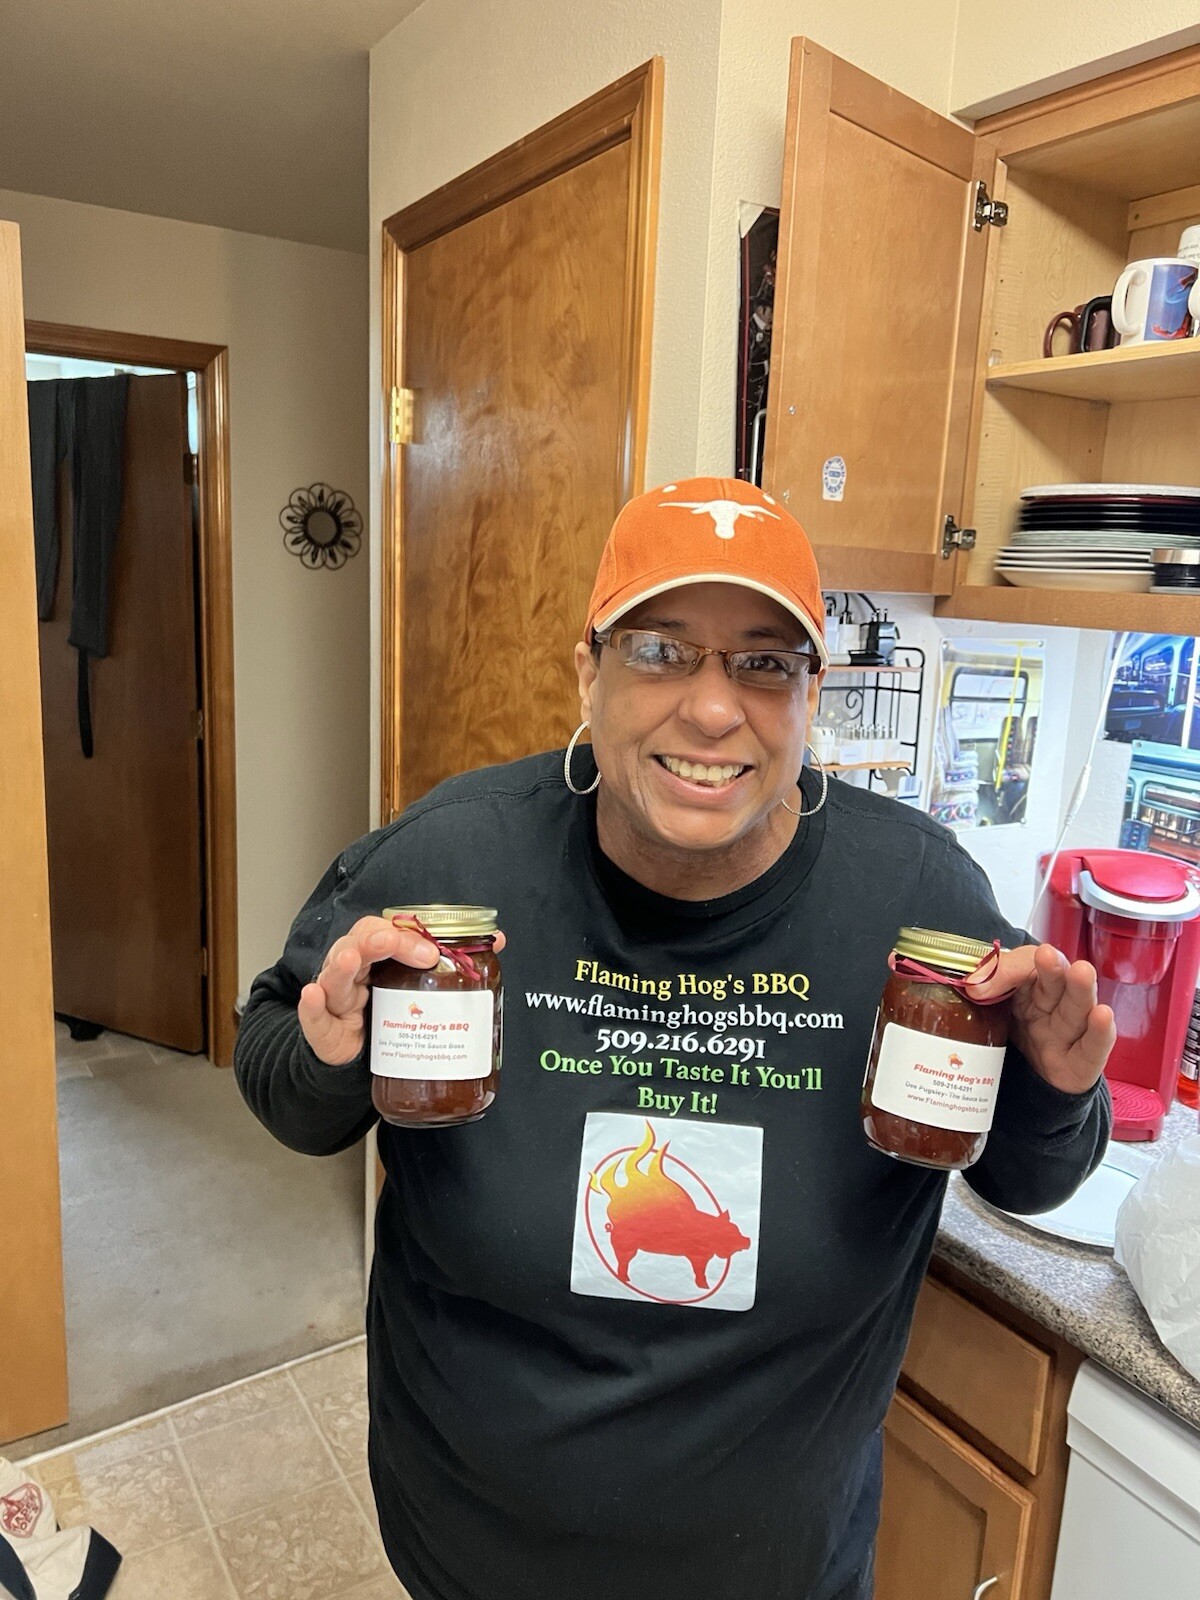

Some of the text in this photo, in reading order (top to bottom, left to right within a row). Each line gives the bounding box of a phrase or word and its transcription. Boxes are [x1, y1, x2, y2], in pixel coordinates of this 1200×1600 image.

[574, 959, 810, 1002] Flaming Hog's BBQ
[383, 1020, 470, 1032] Flaming Hog's BBQ
[525, 991, 845, 1034] www.flaminghogsbbq.com
[595, 1028, 766, 1063] 509.216.6291
[539, 1050, 822, 1090] Once You Taste It You'll
[914, 1063, 955, 1082] Flaming
[957, 1074, 981, 1086] Hog's
[933, 1079, 973, 1093] 509-216-6291
[949, 1091, 961, 1100] The
[637, 1087, 718, 1117] Buy It!
